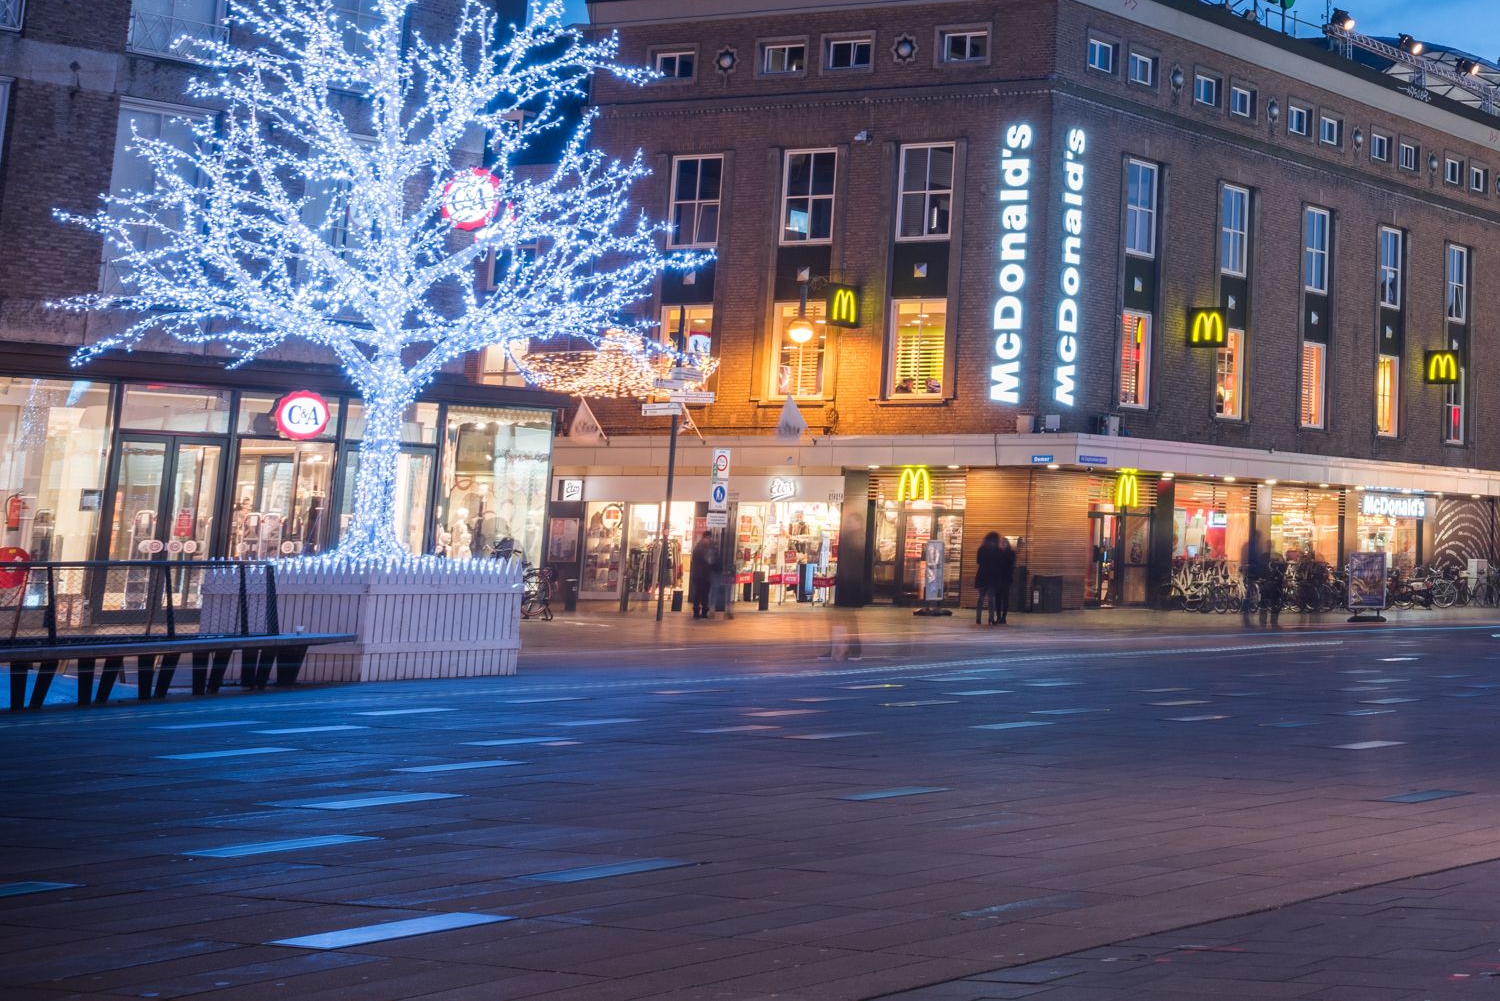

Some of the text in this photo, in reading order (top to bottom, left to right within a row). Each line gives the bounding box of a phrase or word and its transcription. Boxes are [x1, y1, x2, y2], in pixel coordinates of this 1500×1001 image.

[990, 123, 1032, 404] McDonald's
[1054, 127, 1086, 407] McDonald's
[288, 405, 319, 425] C&A
[565, 482, 581, 495] Etos
[770, 479, 796, 497] Etos
[1363, 495, 1425, 517] McDonald's
